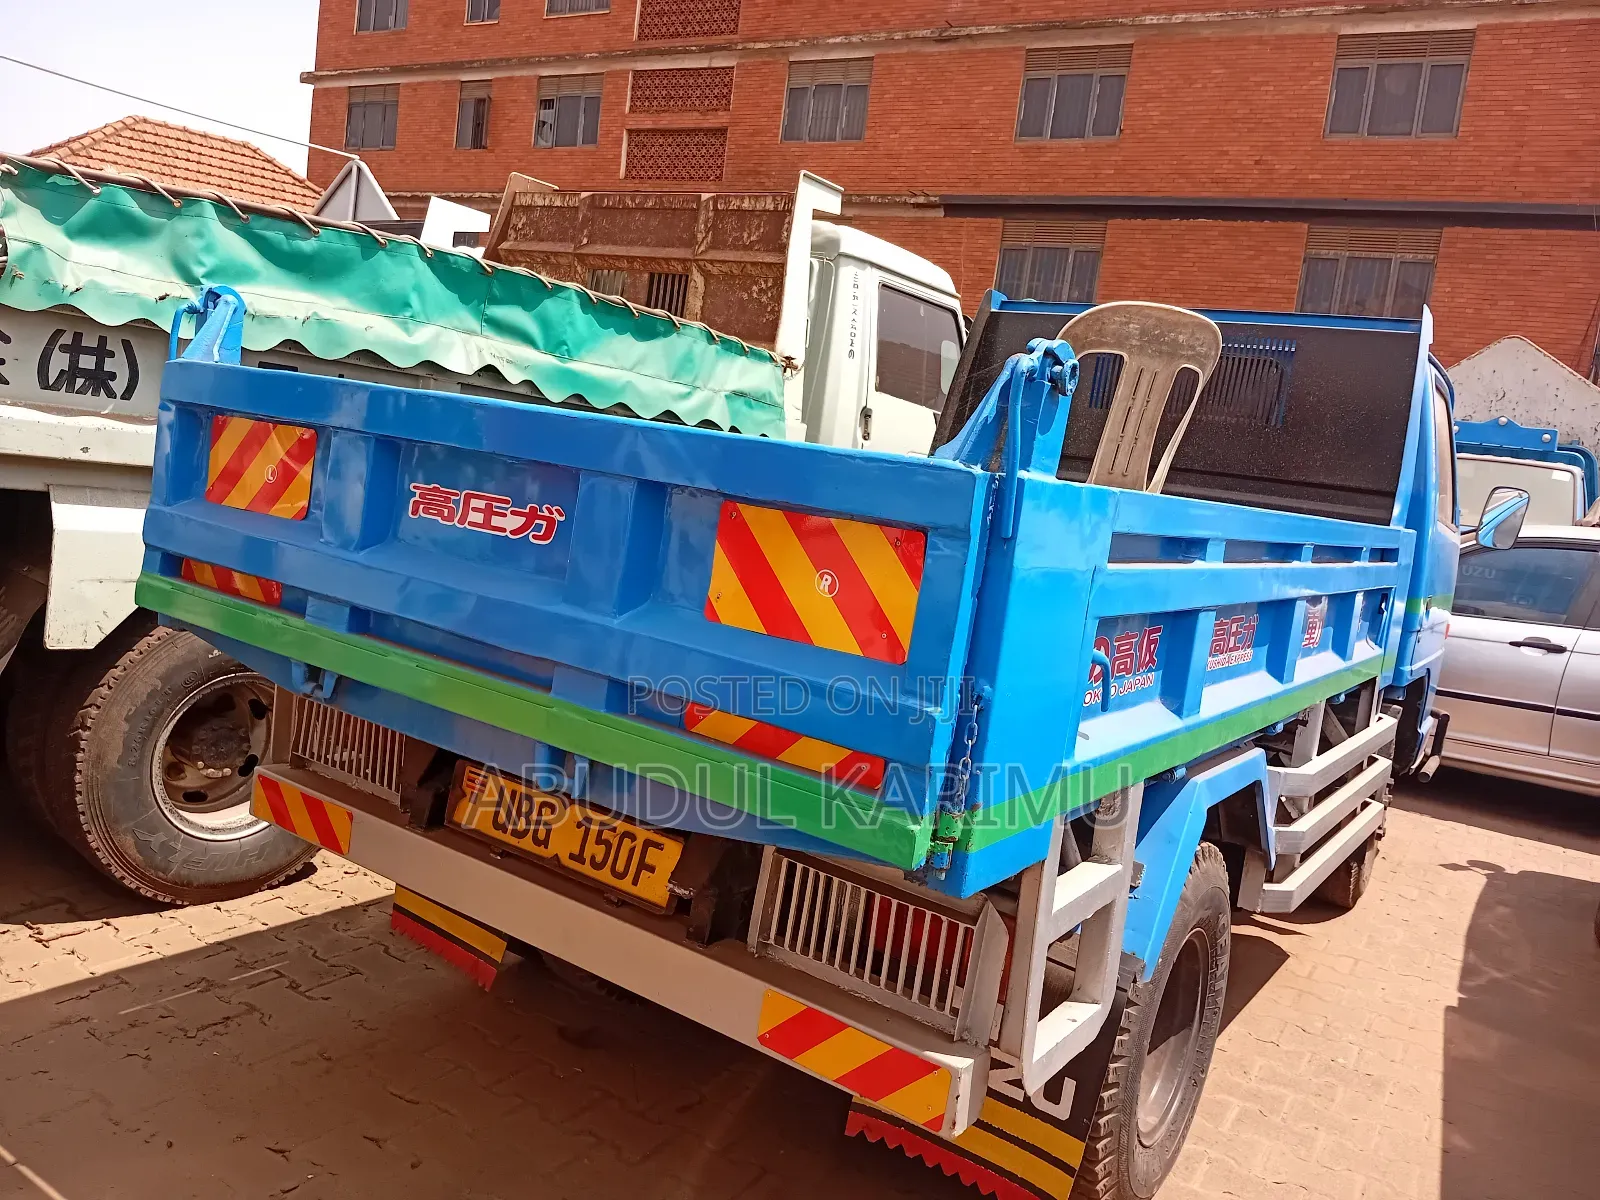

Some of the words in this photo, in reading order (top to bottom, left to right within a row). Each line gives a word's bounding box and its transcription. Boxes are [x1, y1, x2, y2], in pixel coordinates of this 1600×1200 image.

[409, 482, 565, 545] 高圧ガ
[1209, 614, 1259, 658] 高圧ガ
[1119, 671, 1154, 696] JAPAN
[569, 816, 664, 886] 150F
